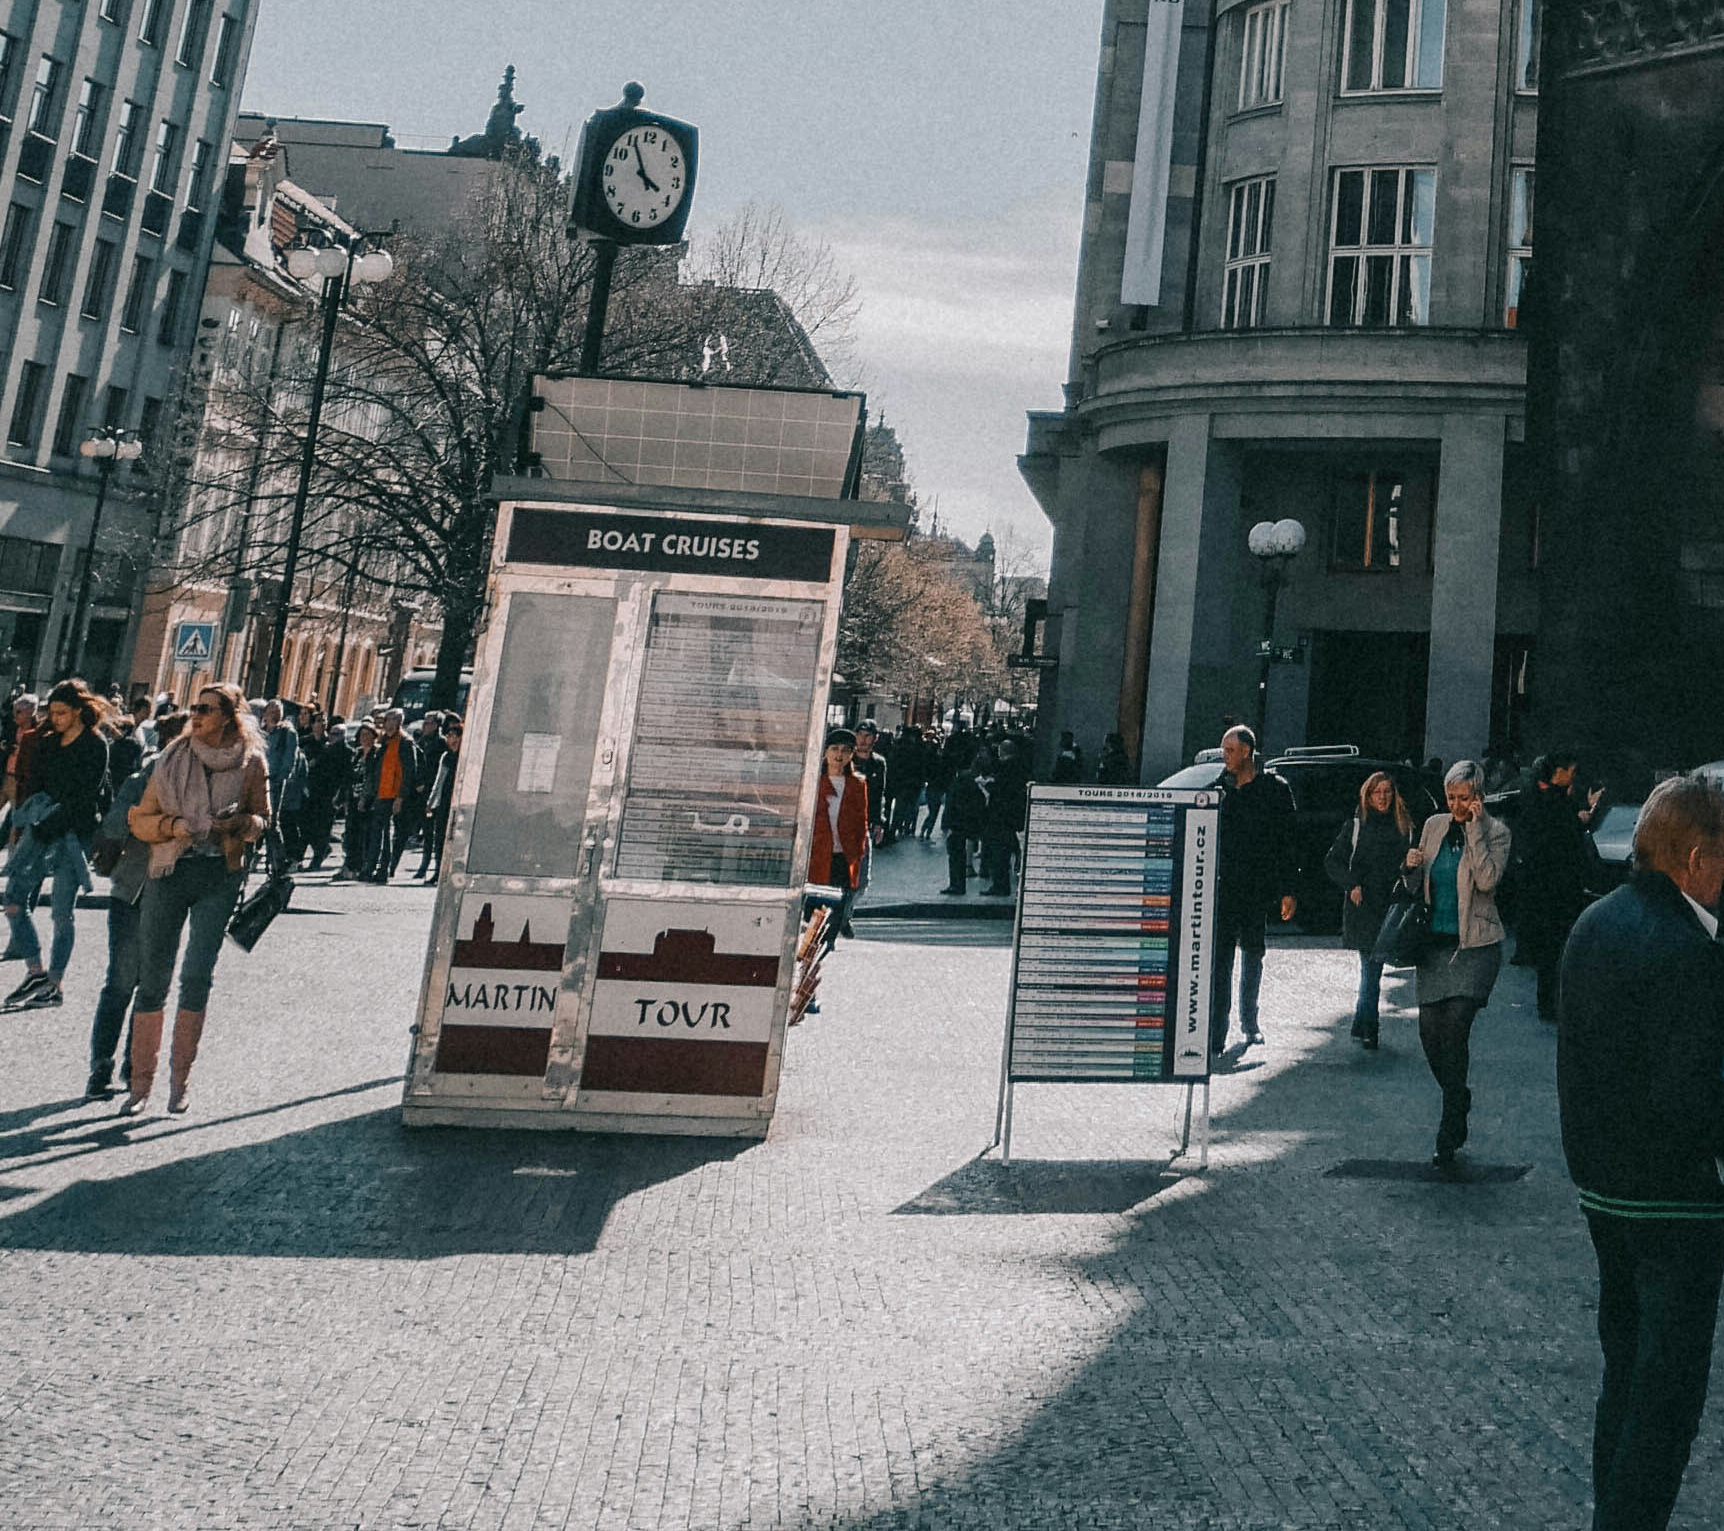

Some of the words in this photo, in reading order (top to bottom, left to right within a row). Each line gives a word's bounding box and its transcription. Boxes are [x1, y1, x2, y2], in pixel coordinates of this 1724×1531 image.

[643, 131, 657, 144] 12
[661, 139, 668, 152] 1
[613, 147, 628, 161] 10
[670, 156, 678, 168] 2
[605, 164, 614, 177] 9
[671, 177, 680, 189] 3
[606, 185, 616, 198] 8
[661, 195, 670, 207] 4
[616, 202, 625, 215] 7
[649, 208, 657, 220] 5
[631, 210, 640, 223] 6
[587, 529, 656, 553] BOAT
[662, 534, 760, 561] CRUISES
[1078, 789, 1113, 797] TOURS
[1187, 825, 1207, 1034] www.martintour.cz
[445, 982, 557, 1012] MARTIN
[633, 998, 731, 1029] TOUR
